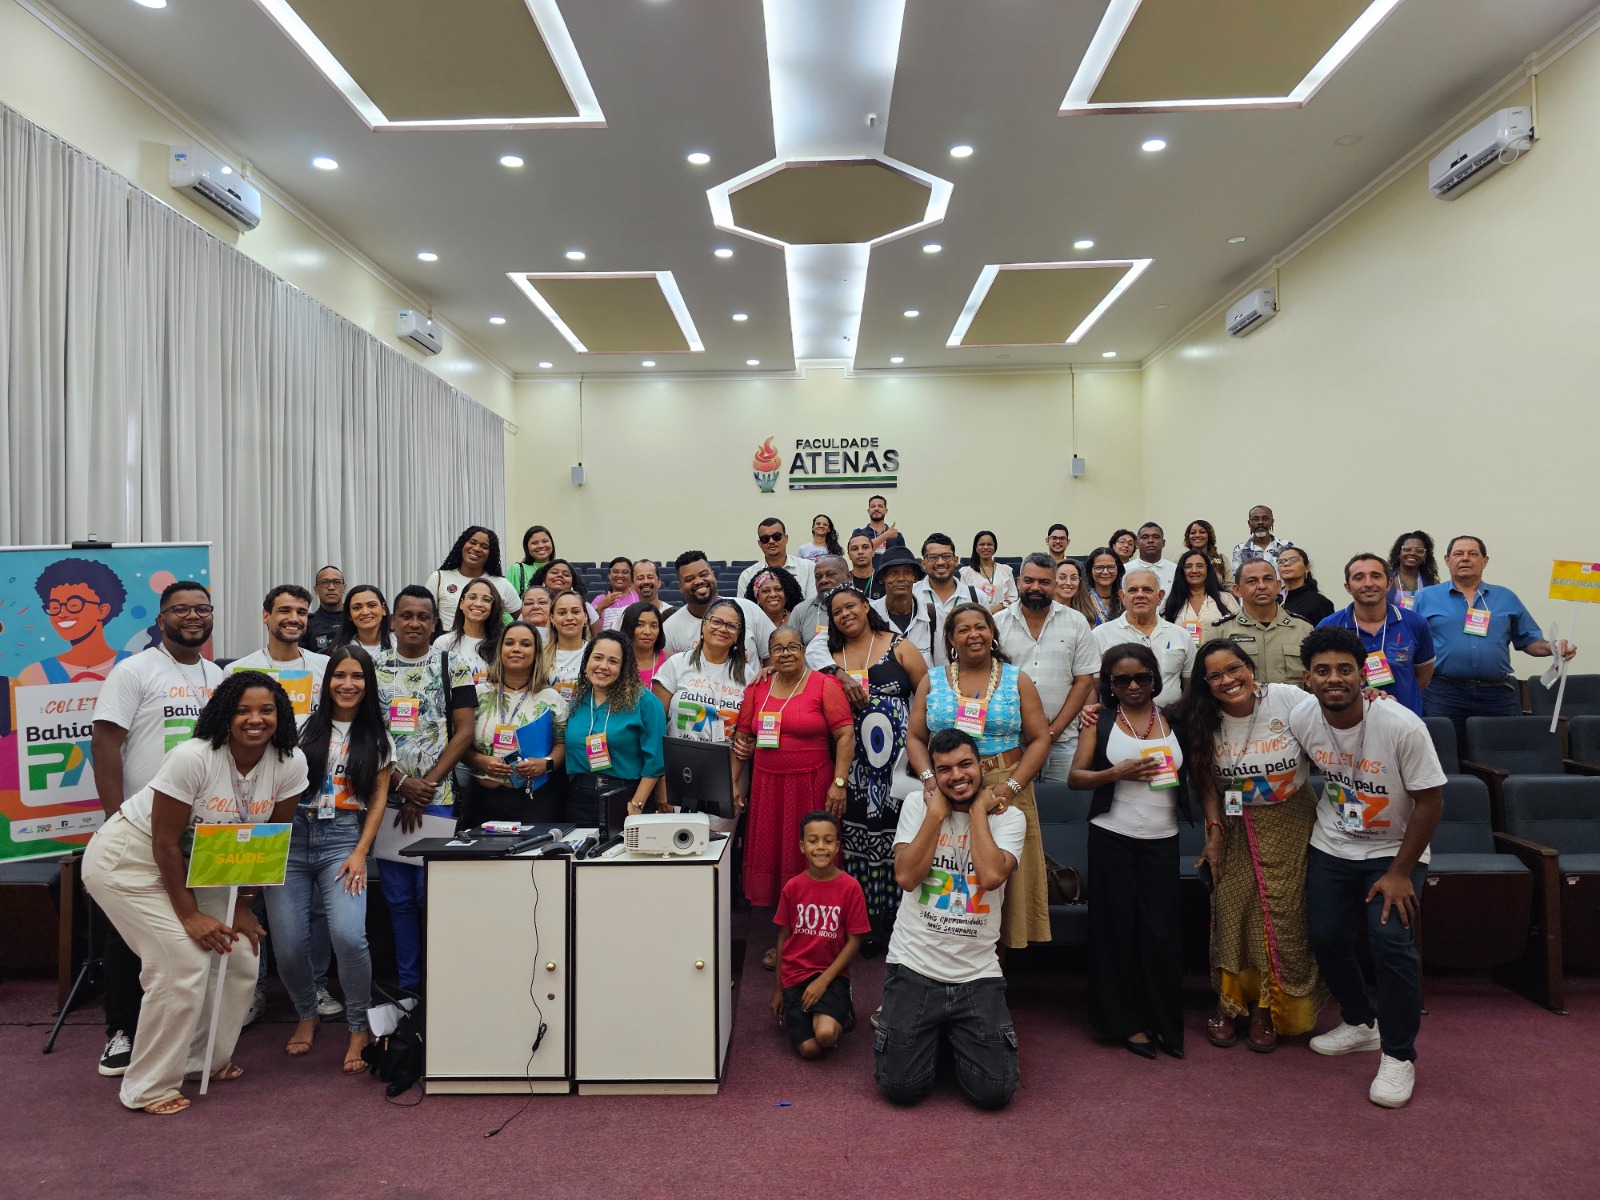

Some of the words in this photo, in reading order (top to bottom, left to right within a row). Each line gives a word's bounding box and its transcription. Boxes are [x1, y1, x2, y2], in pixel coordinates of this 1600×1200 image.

[796, 437, 879, 450] FACULDADE
[789, 449, 900, 475] ATENAS
[1552, 577, 1600, 589] SEGURAN
[44, 697, 98, 715] COLET
[680, 691, 716, 706] Bahia
[677, 701, 739, 738] PAZ
[26, 723, 94, 742] Bahia
[27, 739, 96, 791] PA
[1264, 758, 1298, 775] pela
[1354, 780, 1389, 795] pela
[214, 851, 266, 865] SAÚDE
[918, 868, 991, 914] PAZ
[795, 903, 841, 932] BOYS
[923, 910, 938, 922] Mais
[927, 922, 941, 931] mais
[943, 924, 978, 935] segurança
